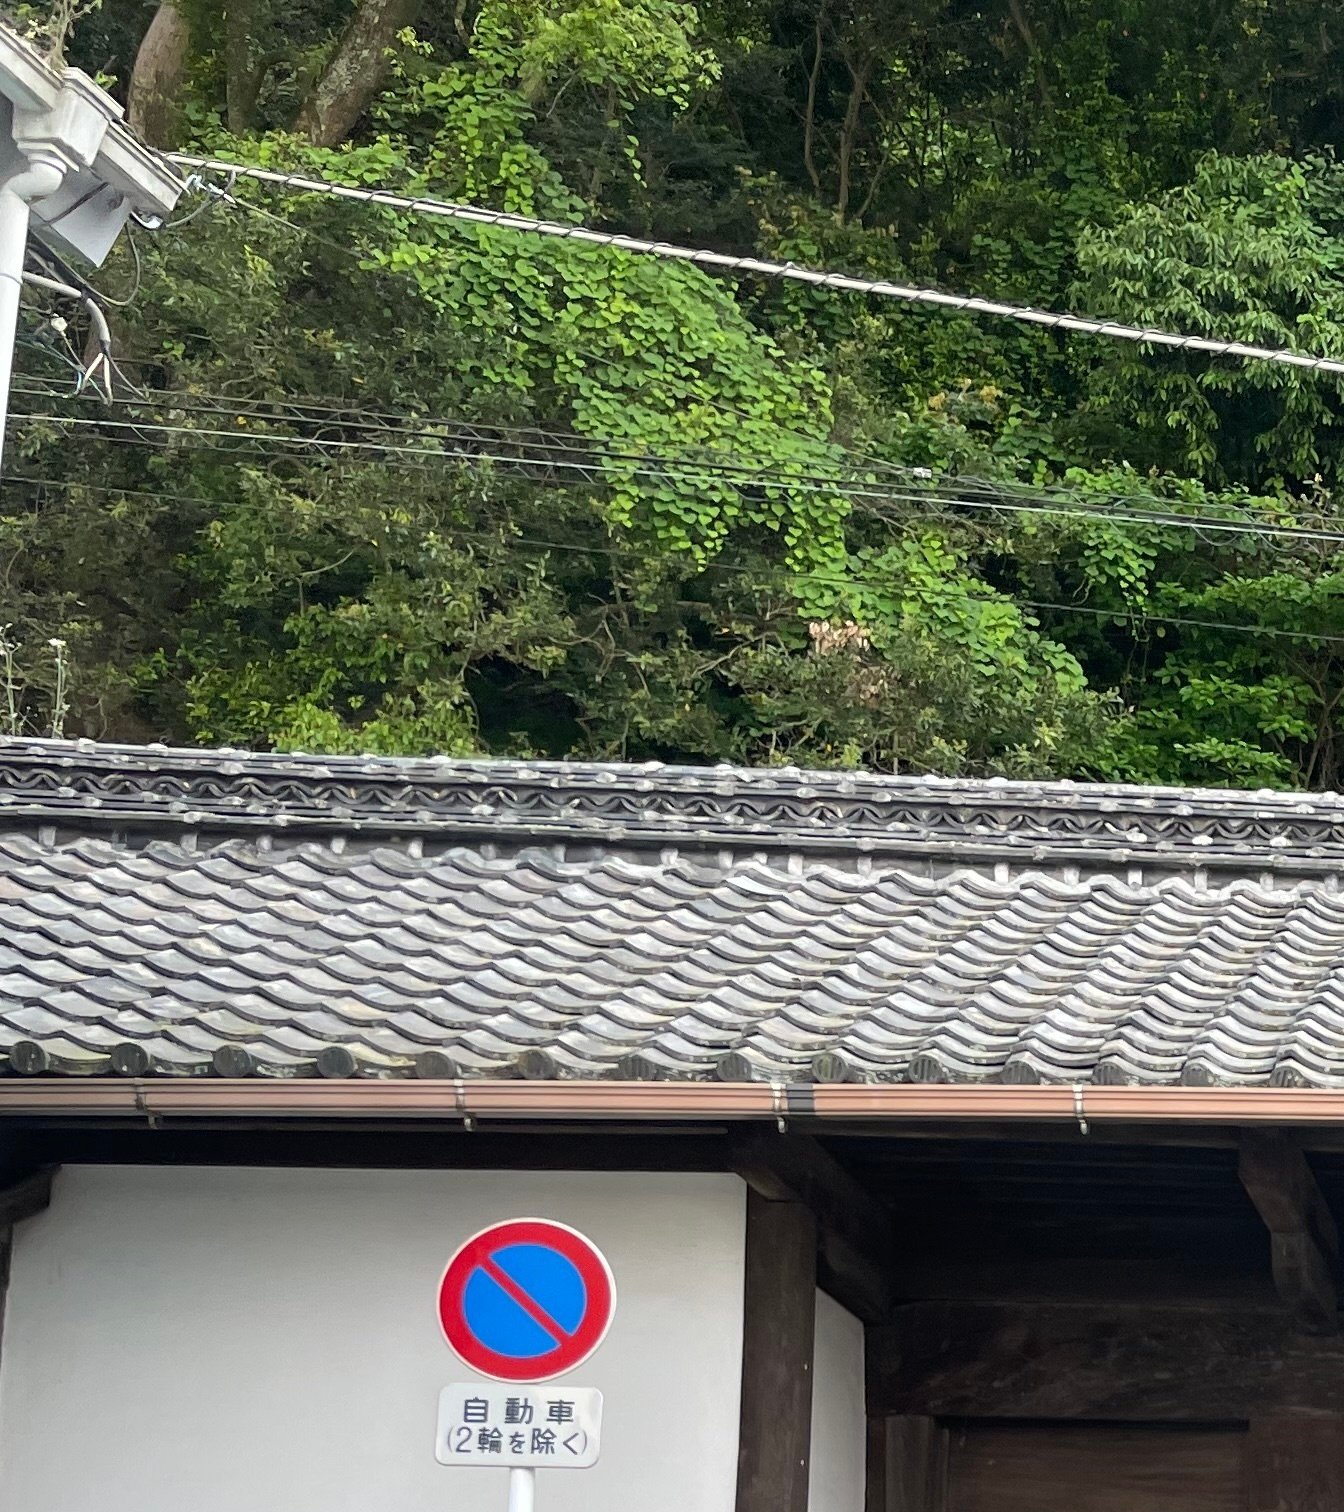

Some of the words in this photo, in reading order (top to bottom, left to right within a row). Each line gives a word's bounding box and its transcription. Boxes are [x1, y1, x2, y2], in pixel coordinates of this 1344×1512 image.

[464, 1397, 575, 1425] 自動車
[447, 1427, 588, 1457] (2輪を除く)
